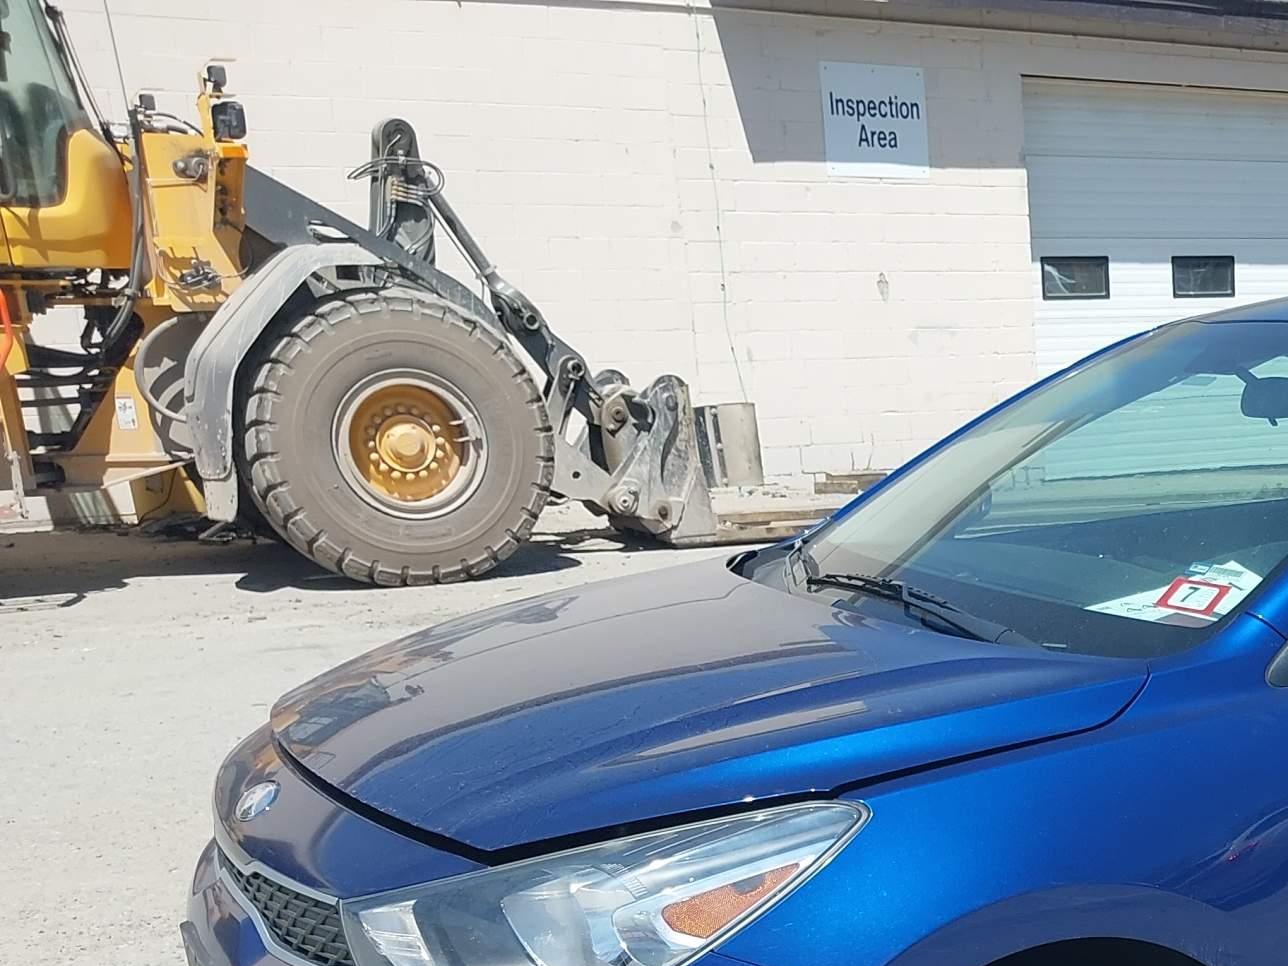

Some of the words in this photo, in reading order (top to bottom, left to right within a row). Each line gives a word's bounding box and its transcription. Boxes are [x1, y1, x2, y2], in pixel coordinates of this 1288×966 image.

[829, 91, 920, 122] Inspection
[858, 123, 898, 149] Area
[1180, 586, 1201, 603] 7
